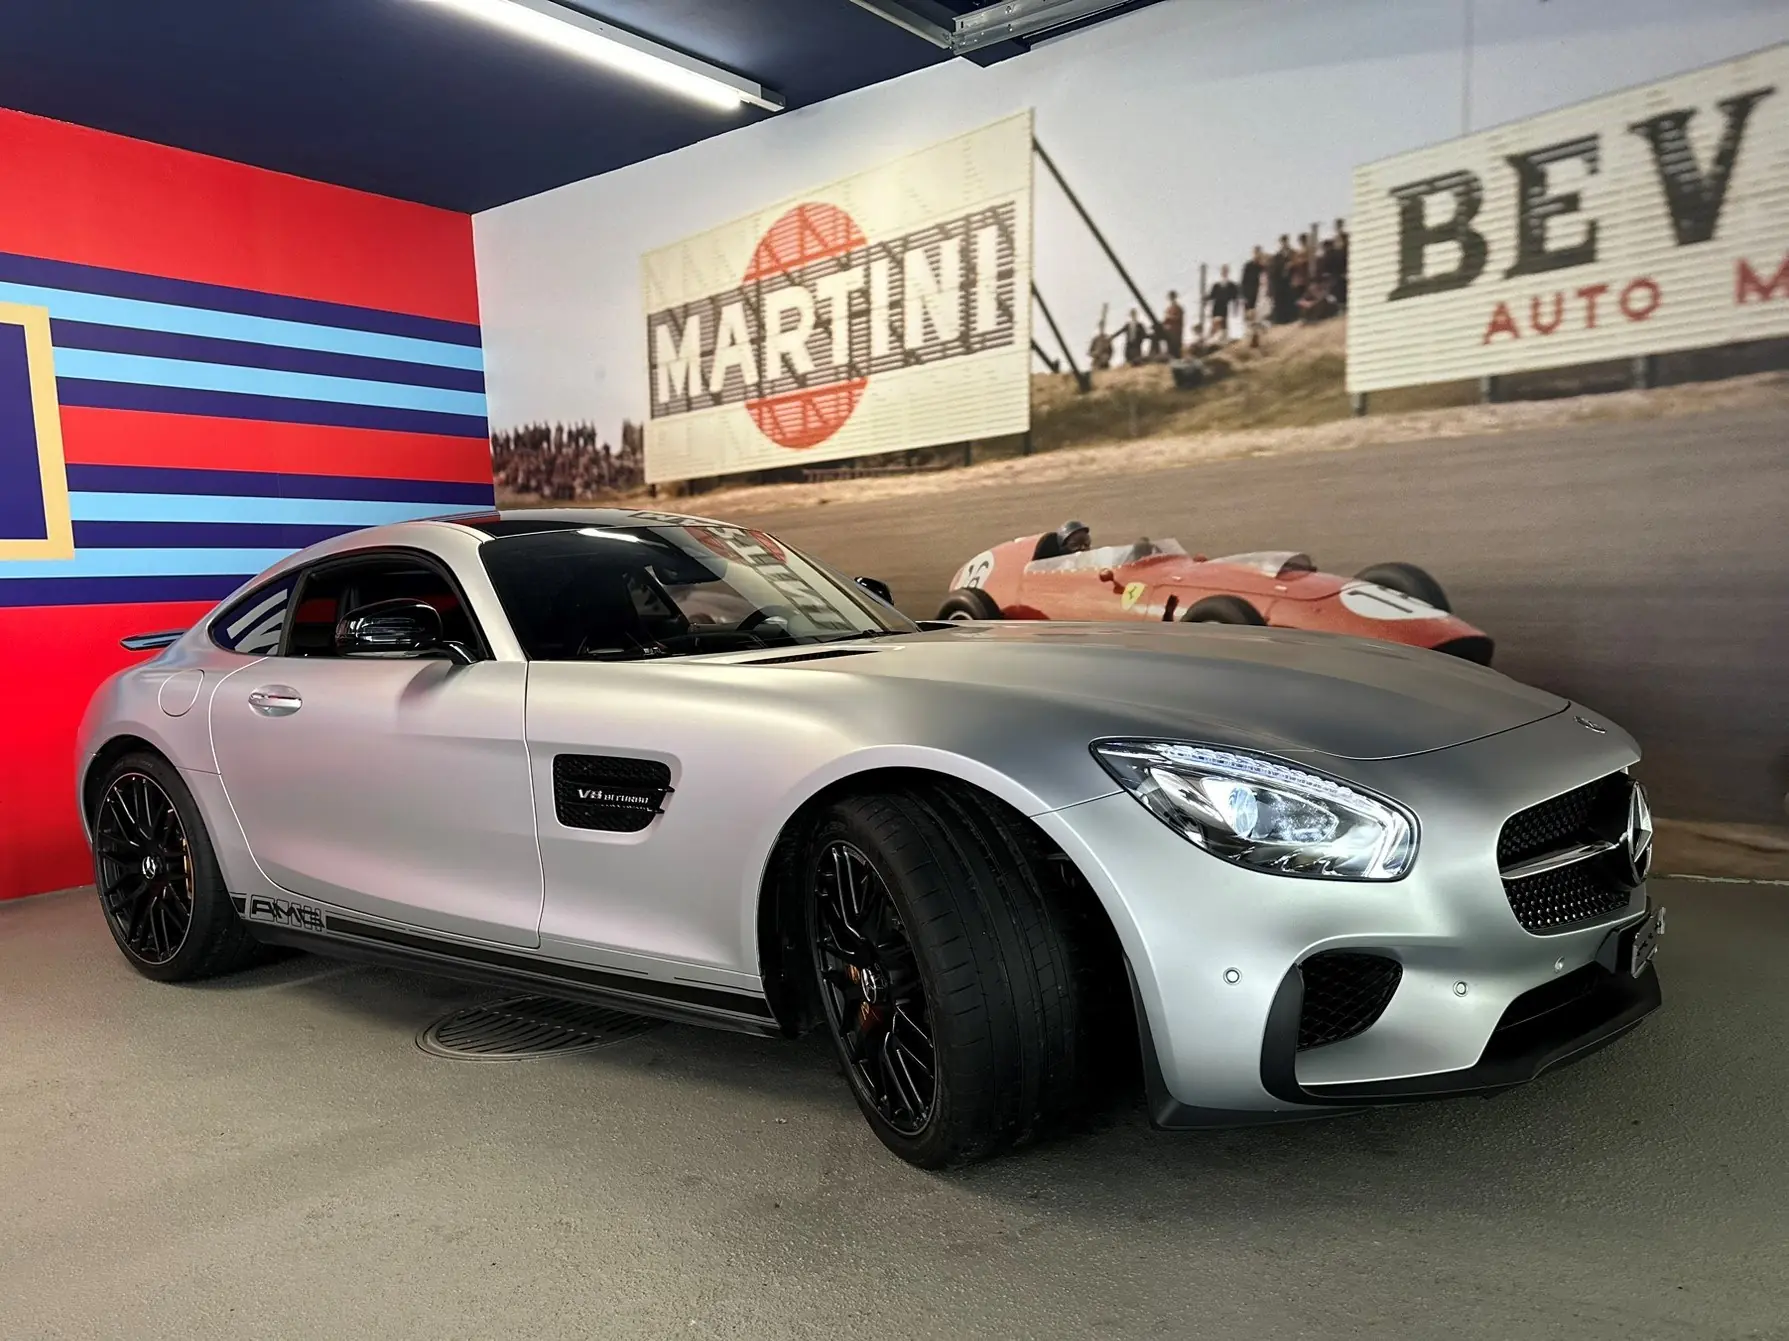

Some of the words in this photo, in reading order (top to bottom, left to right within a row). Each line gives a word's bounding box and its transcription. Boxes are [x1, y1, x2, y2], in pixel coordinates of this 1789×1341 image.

[1387, 86, 1777, 302] BEV
[653, 223, 1002, 405] MARTINI
[1483, 277, 1662, 346] AUTO
[577, 788, 603, 800] V8
[251, 896, 325, 930] AMG
